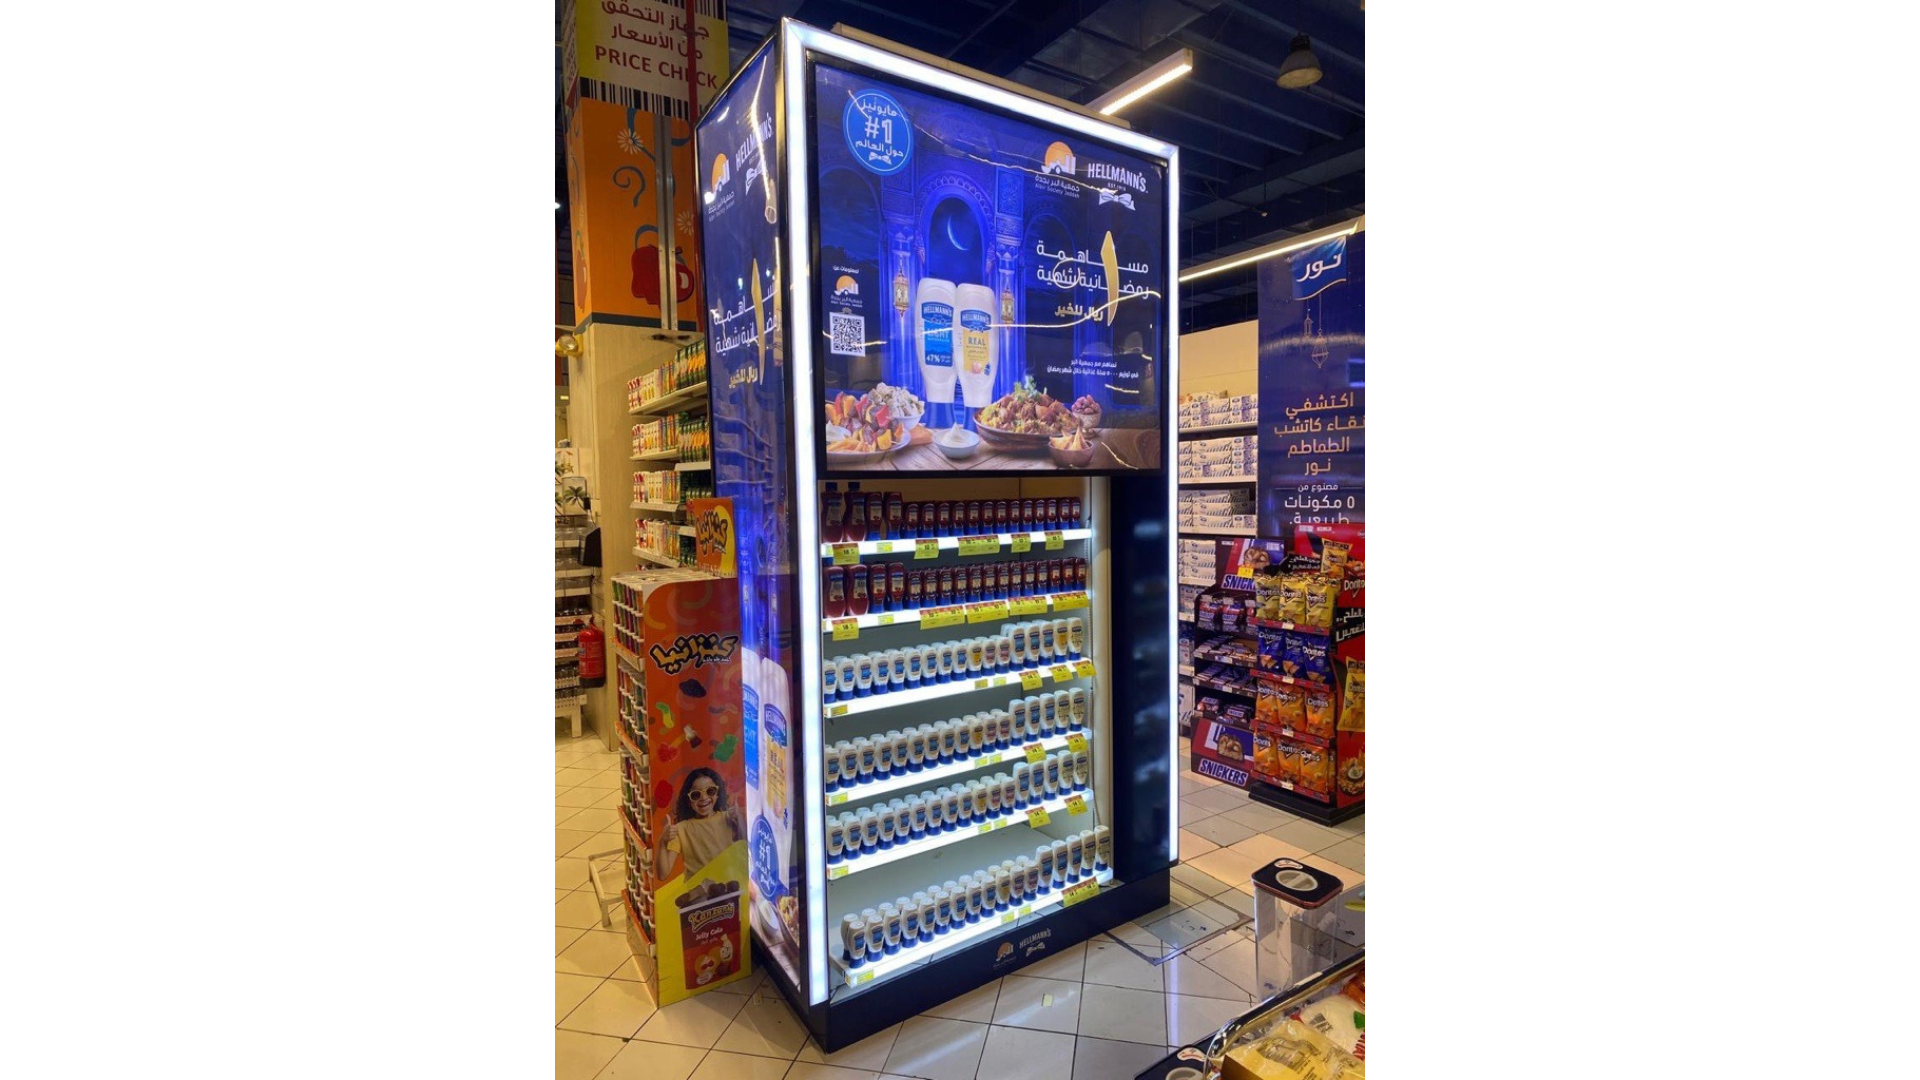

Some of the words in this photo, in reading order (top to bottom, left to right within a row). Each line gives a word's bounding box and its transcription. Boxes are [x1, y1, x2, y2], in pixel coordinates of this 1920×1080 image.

[611, 23, 674, 50] الأسعار
[595, 45, 652, 74] PRICE
[658, 62, 718, 90] CHCK
[856, 138, 884, 152] العالم
[1296, 252, 1342, 282] نور
[968, 336, 986, 346] REAL
[1286, 391, 1354, 420] اكتشفي
[1274, 418, 1322, 438] كاتشب
[1288, 436, 1350, 458] الطماطم
[1304, 458, 1331, 476] نور
[1298, 482, 1308, 492] من
[1312, 482, 1338, 492] مصنوع
[1284, 494, 1342, 512] مكونات
[1302, 646, 1326, 656] Doritos
[1200, 758, 1247, 786] SNICKERS
[1019, 928, 1052, 949] HELLMANN'S
